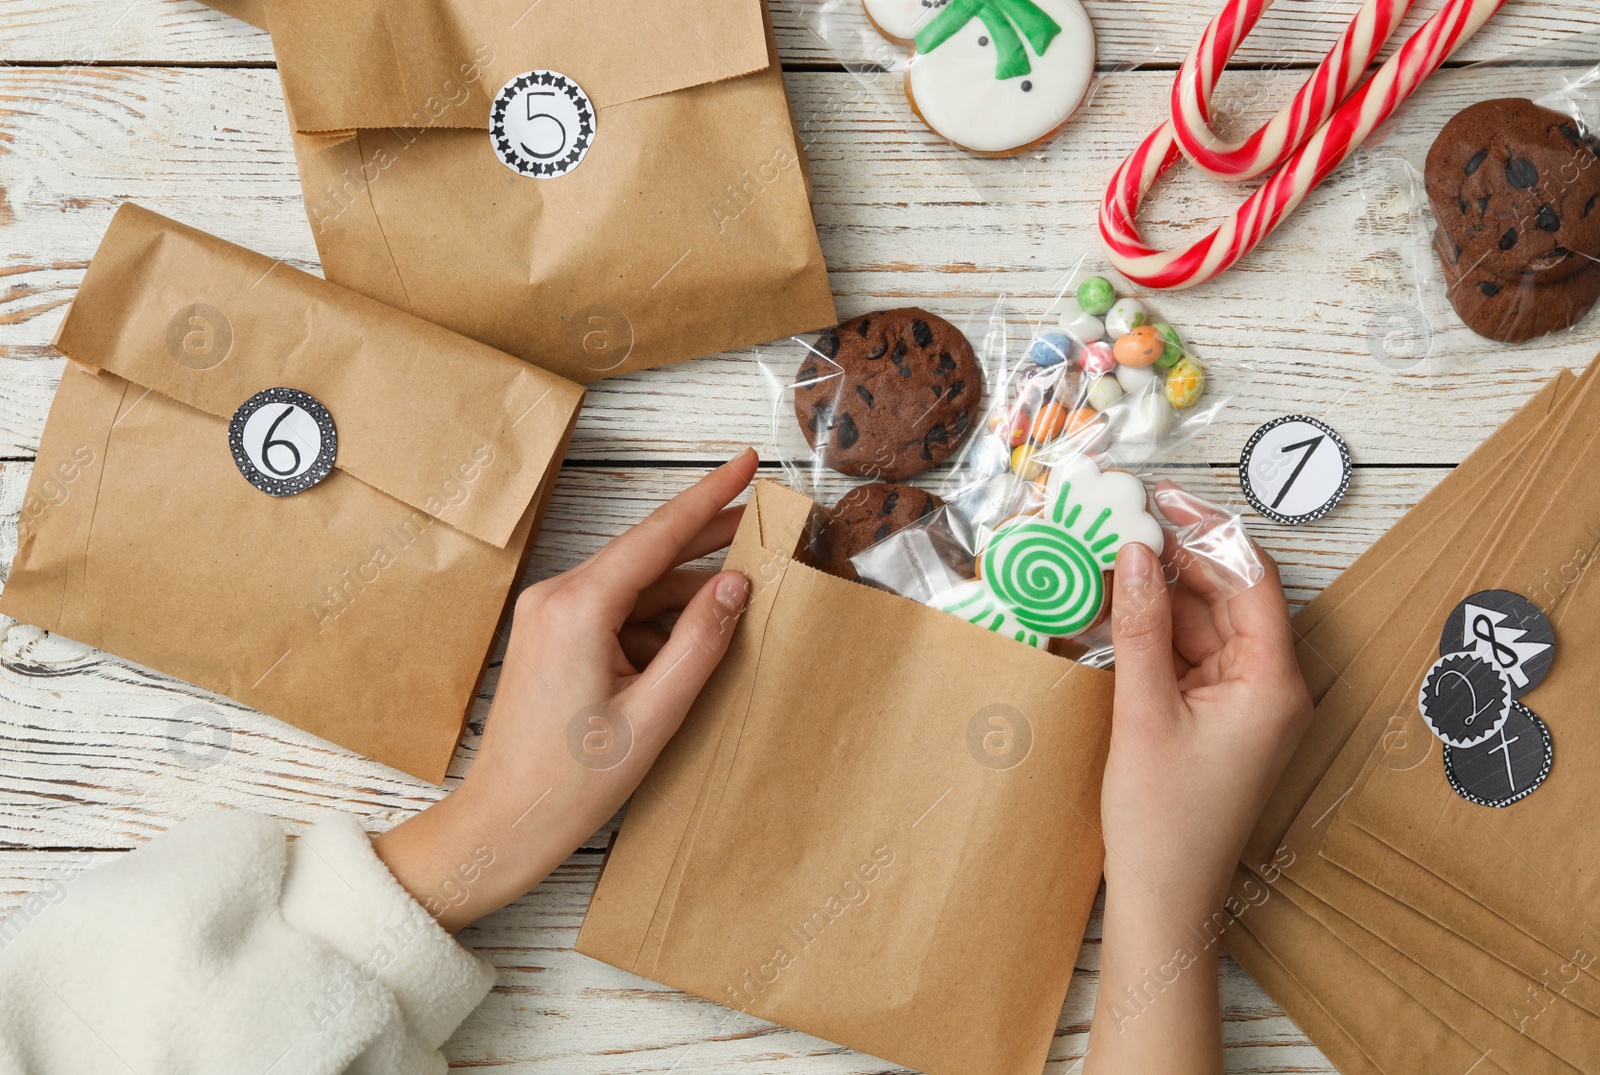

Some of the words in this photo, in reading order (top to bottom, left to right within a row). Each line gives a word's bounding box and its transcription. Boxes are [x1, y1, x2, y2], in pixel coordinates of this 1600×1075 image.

[520, 91, 566, 159] 5
[261, 405, 301, 476] 6
[1472, 613, 1519, 668] 8
[1434, 669, 1496, 726] 2
